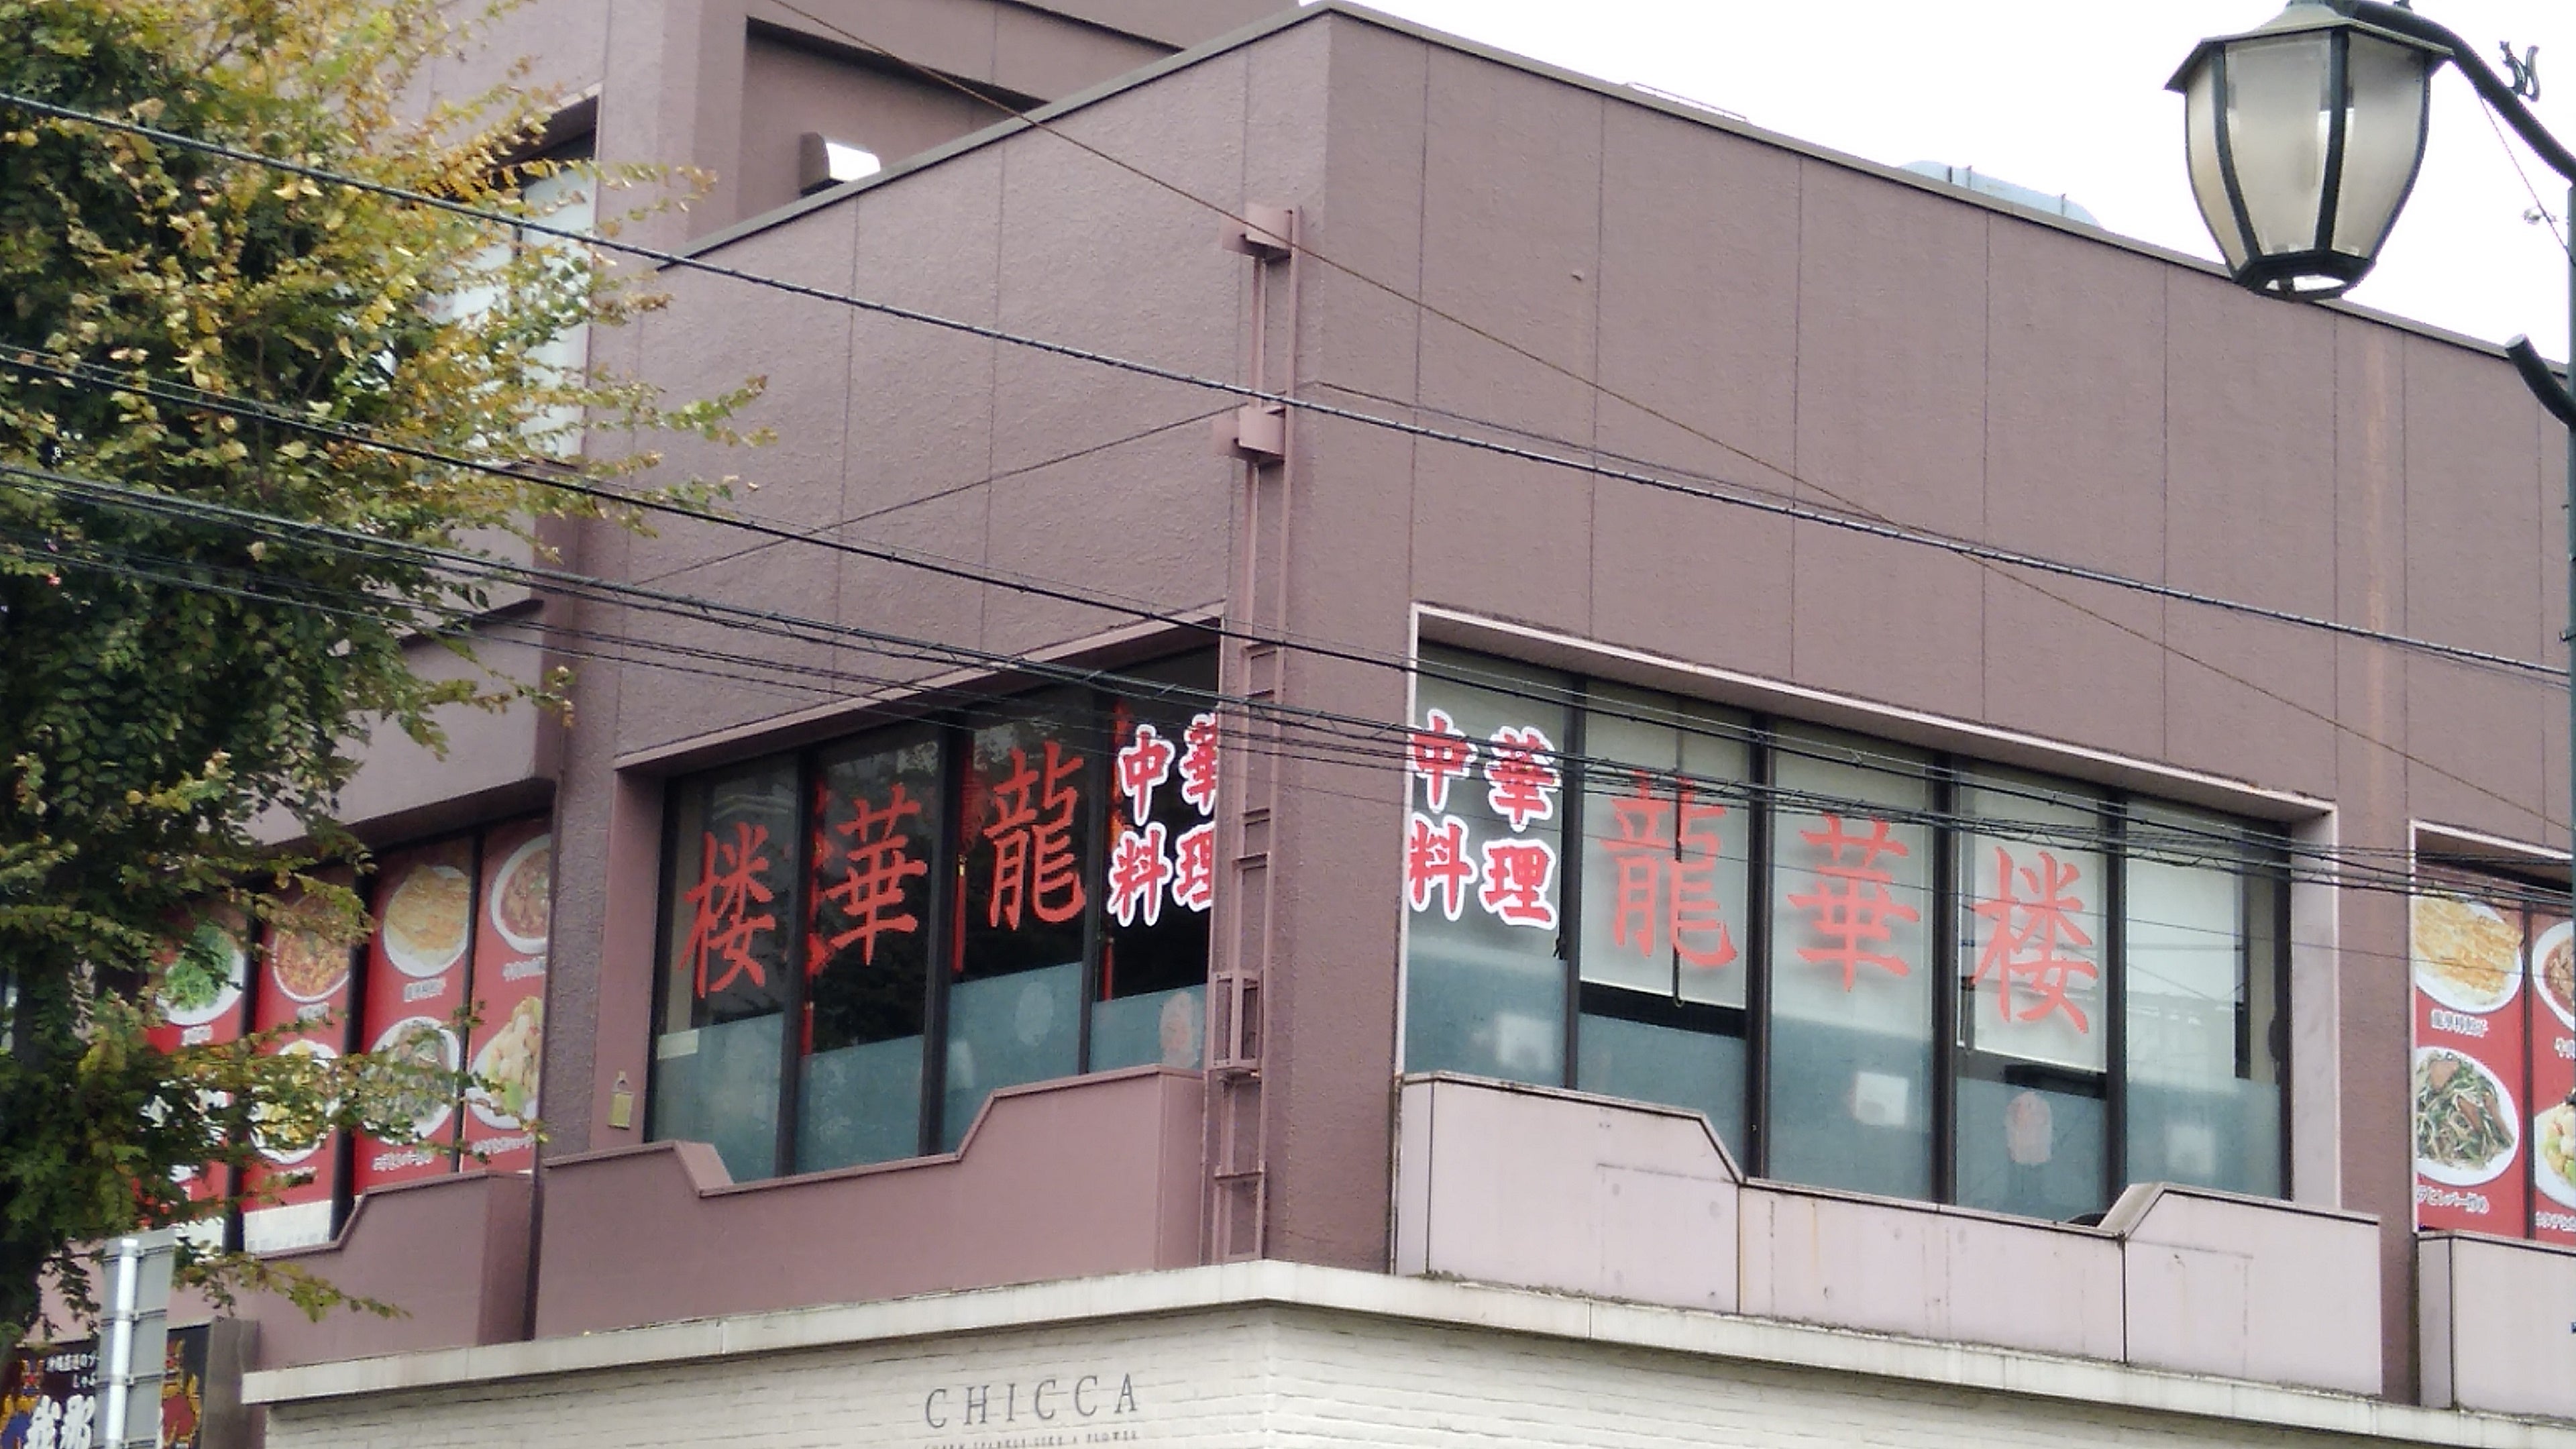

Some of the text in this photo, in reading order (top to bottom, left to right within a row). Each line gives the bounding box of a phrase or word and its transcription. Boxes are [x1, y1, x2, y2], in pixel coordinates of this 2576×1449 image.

[1118, 713, 1216, 826] 中華
[1409, 709, 1561, 832] 中華
[1107, 822, 1214, 927] 料理
[1408, 812, 1557, 930] 料理
[925, 1373, 1138, 1428] CHICCA
